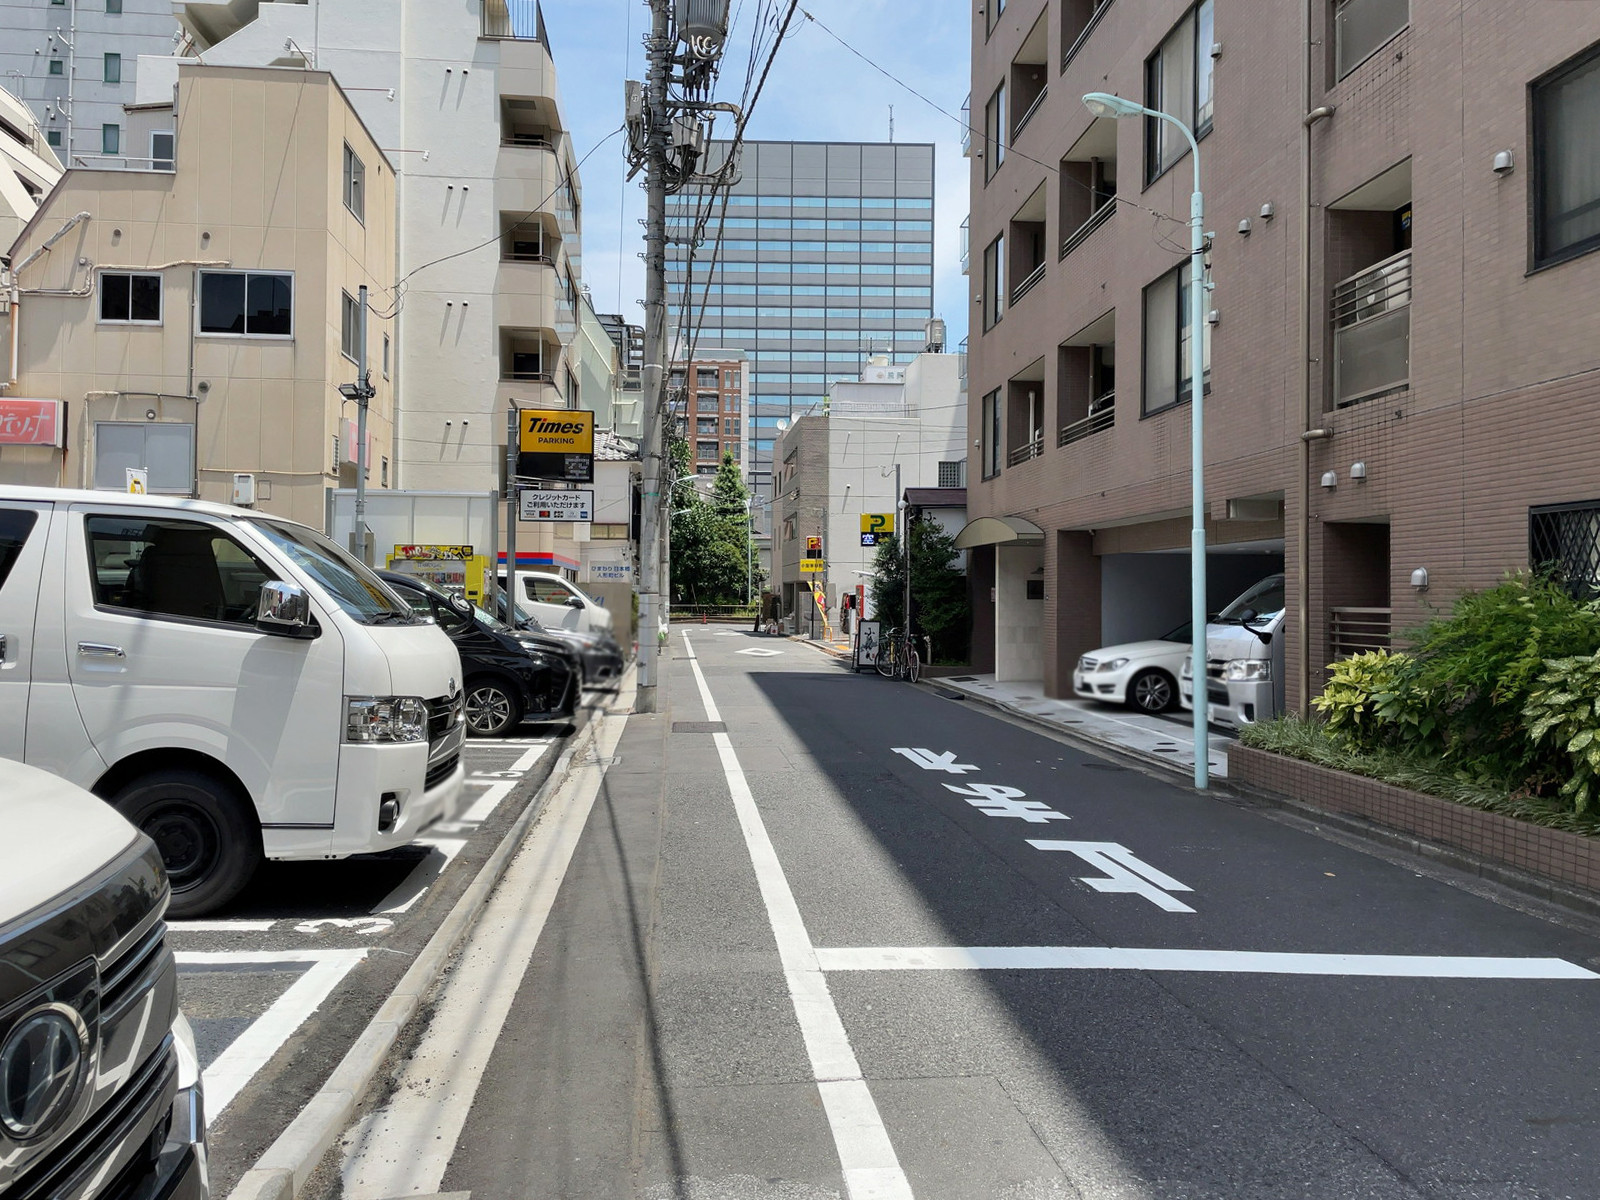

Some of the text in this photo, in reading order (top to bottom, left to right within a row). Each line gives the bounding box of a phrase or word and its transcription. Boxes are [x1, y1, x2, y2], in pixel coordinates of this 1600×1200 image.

[528, 417, 584, 435] Times
[538, 437, 575, 445] PARKING
[532, 493, 581, 501] クレジットカード
[526, 501, 586, 509] ご利用いただけます
[890, 747, 1198, 914] 止まれ
